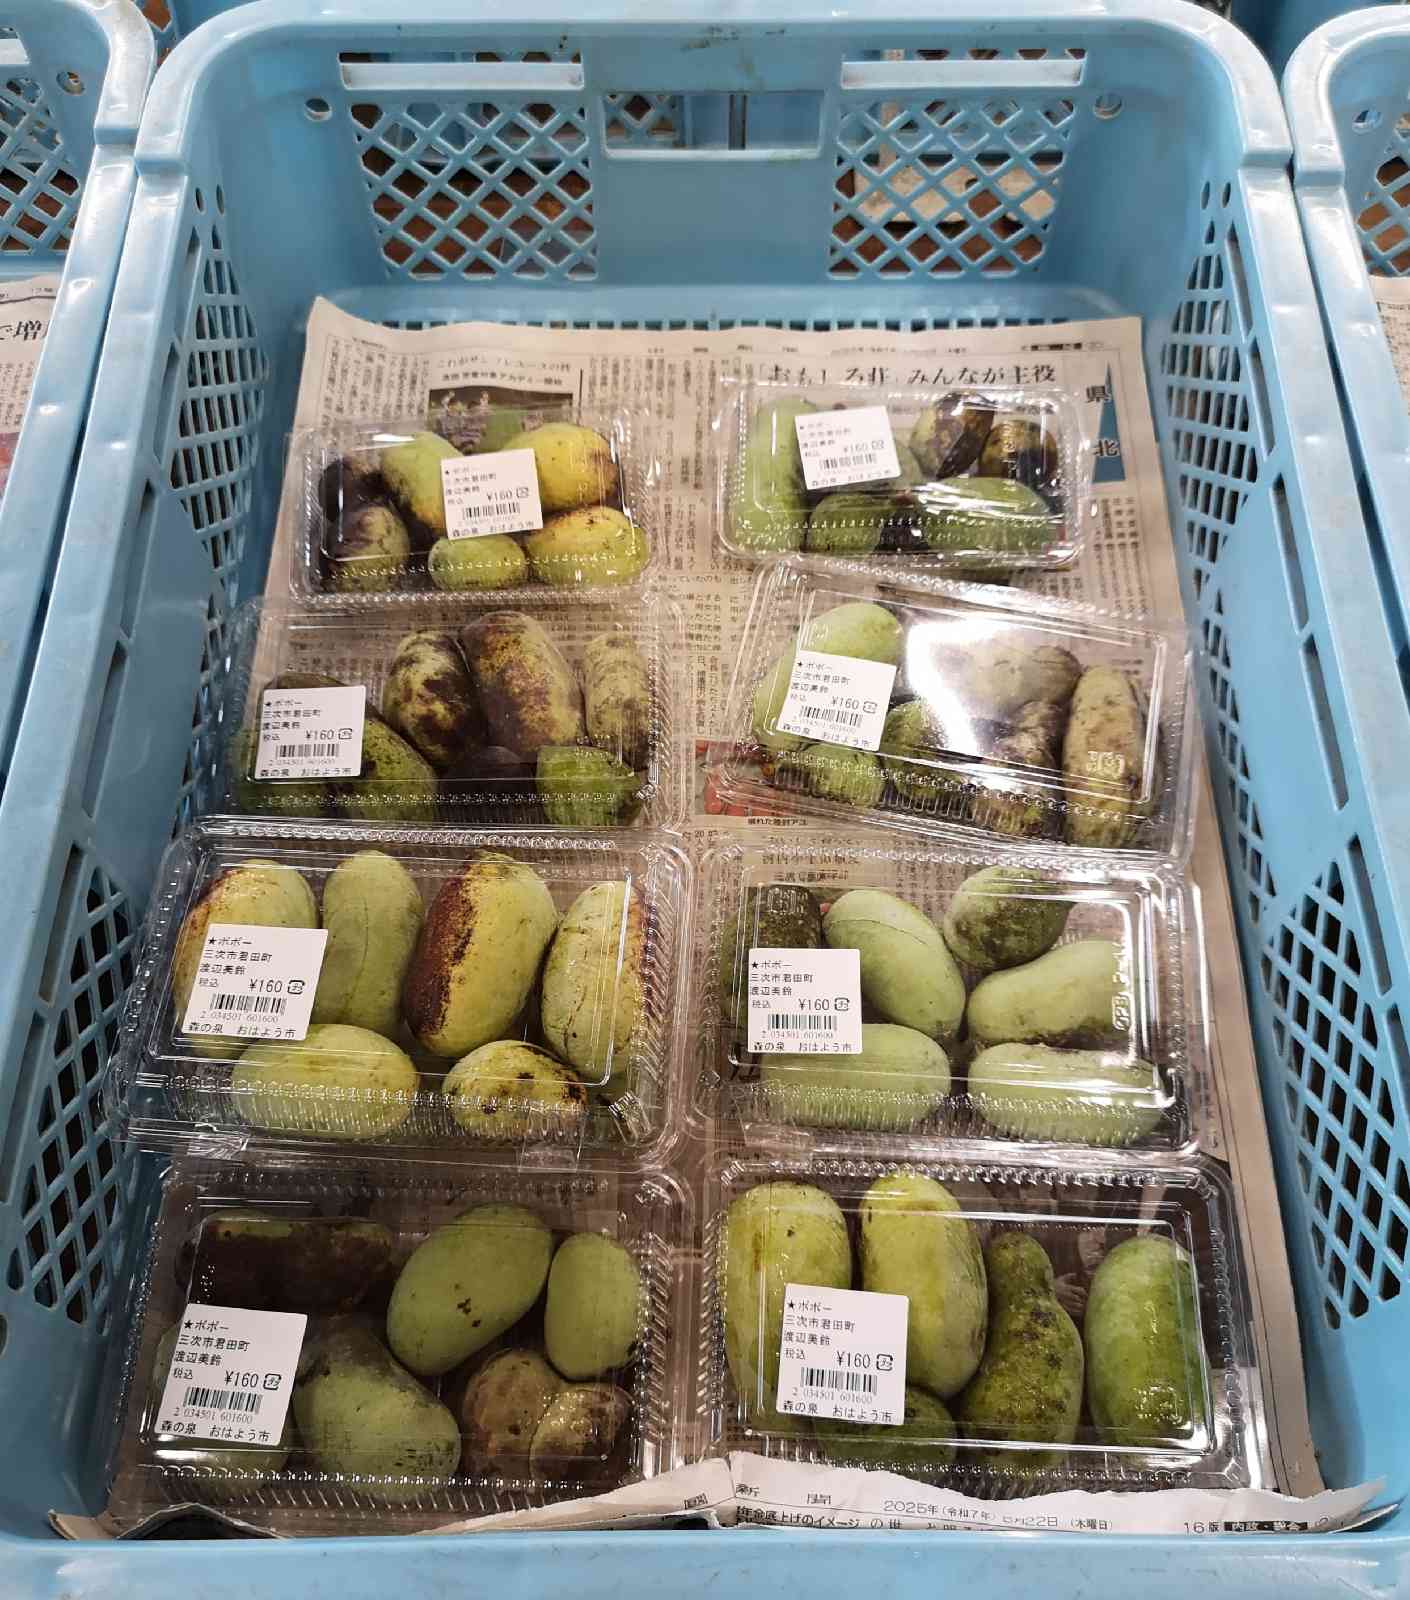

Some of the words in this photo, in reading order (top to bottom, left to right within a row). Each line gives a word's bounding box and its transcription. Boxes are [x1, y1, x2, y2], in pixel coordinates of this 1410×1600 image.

[486, 488, 513, 502] ¥160
[831, 695, 861, 711] ¥160
[305, 729, 335, 741] ¥160
[203, 949, 273, 963] 三次市君田町
[200, 962, 247, 976] 渡辺美鈴
[247, 978, 284, 994] ¥160
[751, 972, 814, 984] 三次市君田町
[751, 985, 792, 997] 渡辺美鈴
[798, 998, 831, 1011] ¥160
[187, 1022, 224, 1034] 森の泉
[237, 1025, 297, 1039] おはよう市
[753, 1041, 785, 1052] 森の泉
[799, 1042, 853, 1052] おはよう市
[783, 1314, 857, 1334] 三次市君田町
[179, 1333, 252, 1352] 三次市君田町
[783, 1329, 831, 1347] 渡辺美鈴
[173, 1349, 223, 1367] 渡辺美鈴
[836, 1349, 871, 1370] ¥160
[224, 1369, 260, 1389] ¥160
[183, 1407, 216, 1422] 034501
[220, 1411, 254, 1425] 601600
[783, 1399, 820, 1415] 森の泉
[832, 1405, 895, 1424] おはよう市
[159, 1419, 197, 1435] 森の泉
[209, 1424, 272, 1443] おはよう市
